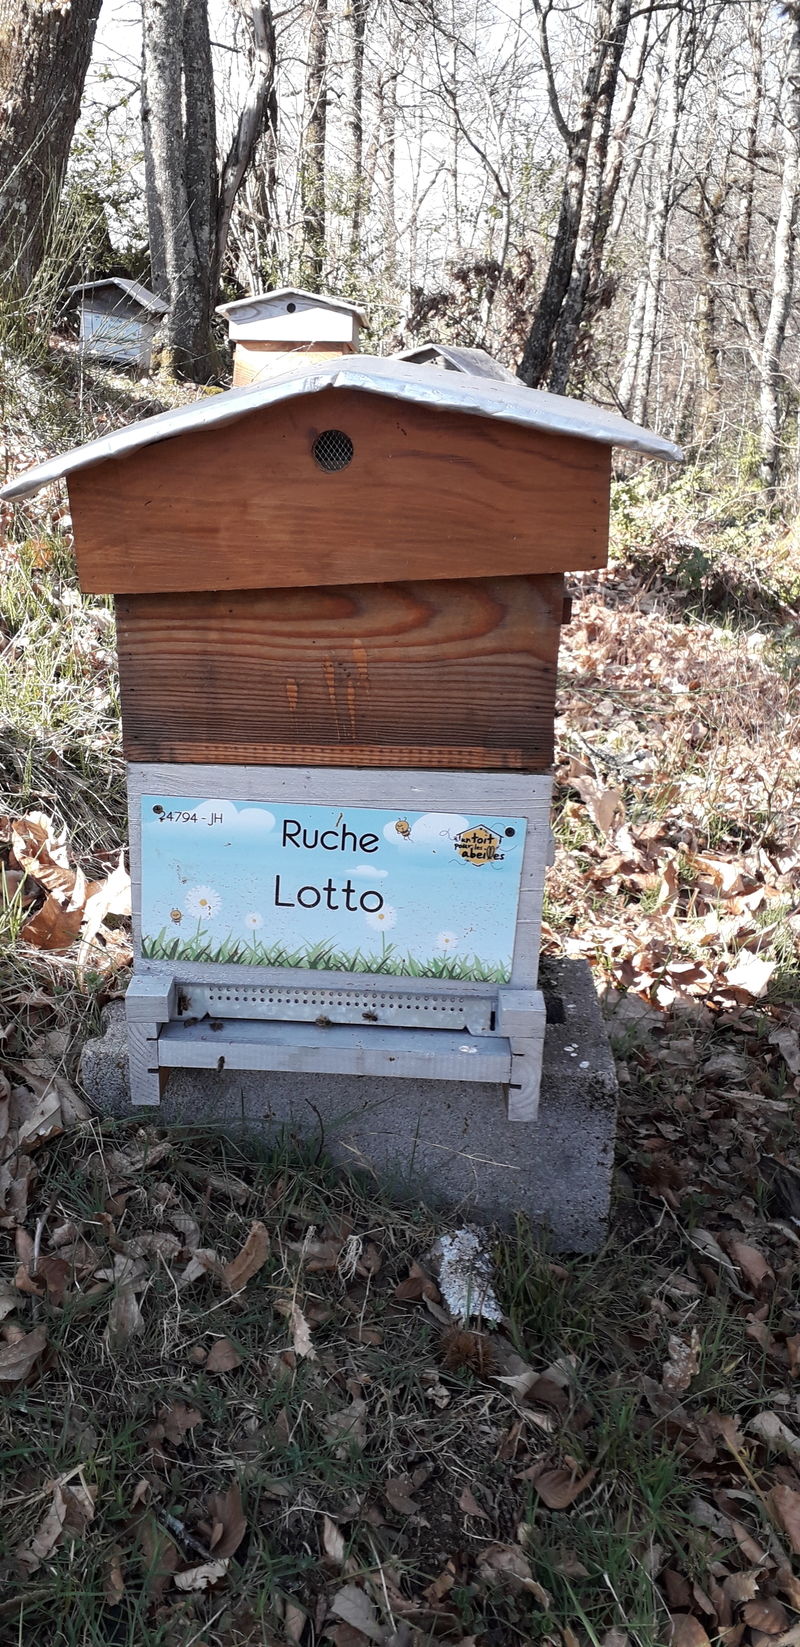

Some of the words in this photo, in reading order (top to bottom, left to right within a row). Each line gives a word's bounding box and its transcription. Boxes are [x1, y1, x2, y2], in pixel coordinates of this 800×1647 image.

[158, 810, 198, 823] 24794
[207, 812, 223, 826] JH
[281, 819, 380, 853] Ruche
[471, 832, 495, 844] toit
[462, 846, 505, 860] abeilles
[274, 874, 385, 913] Lotto
